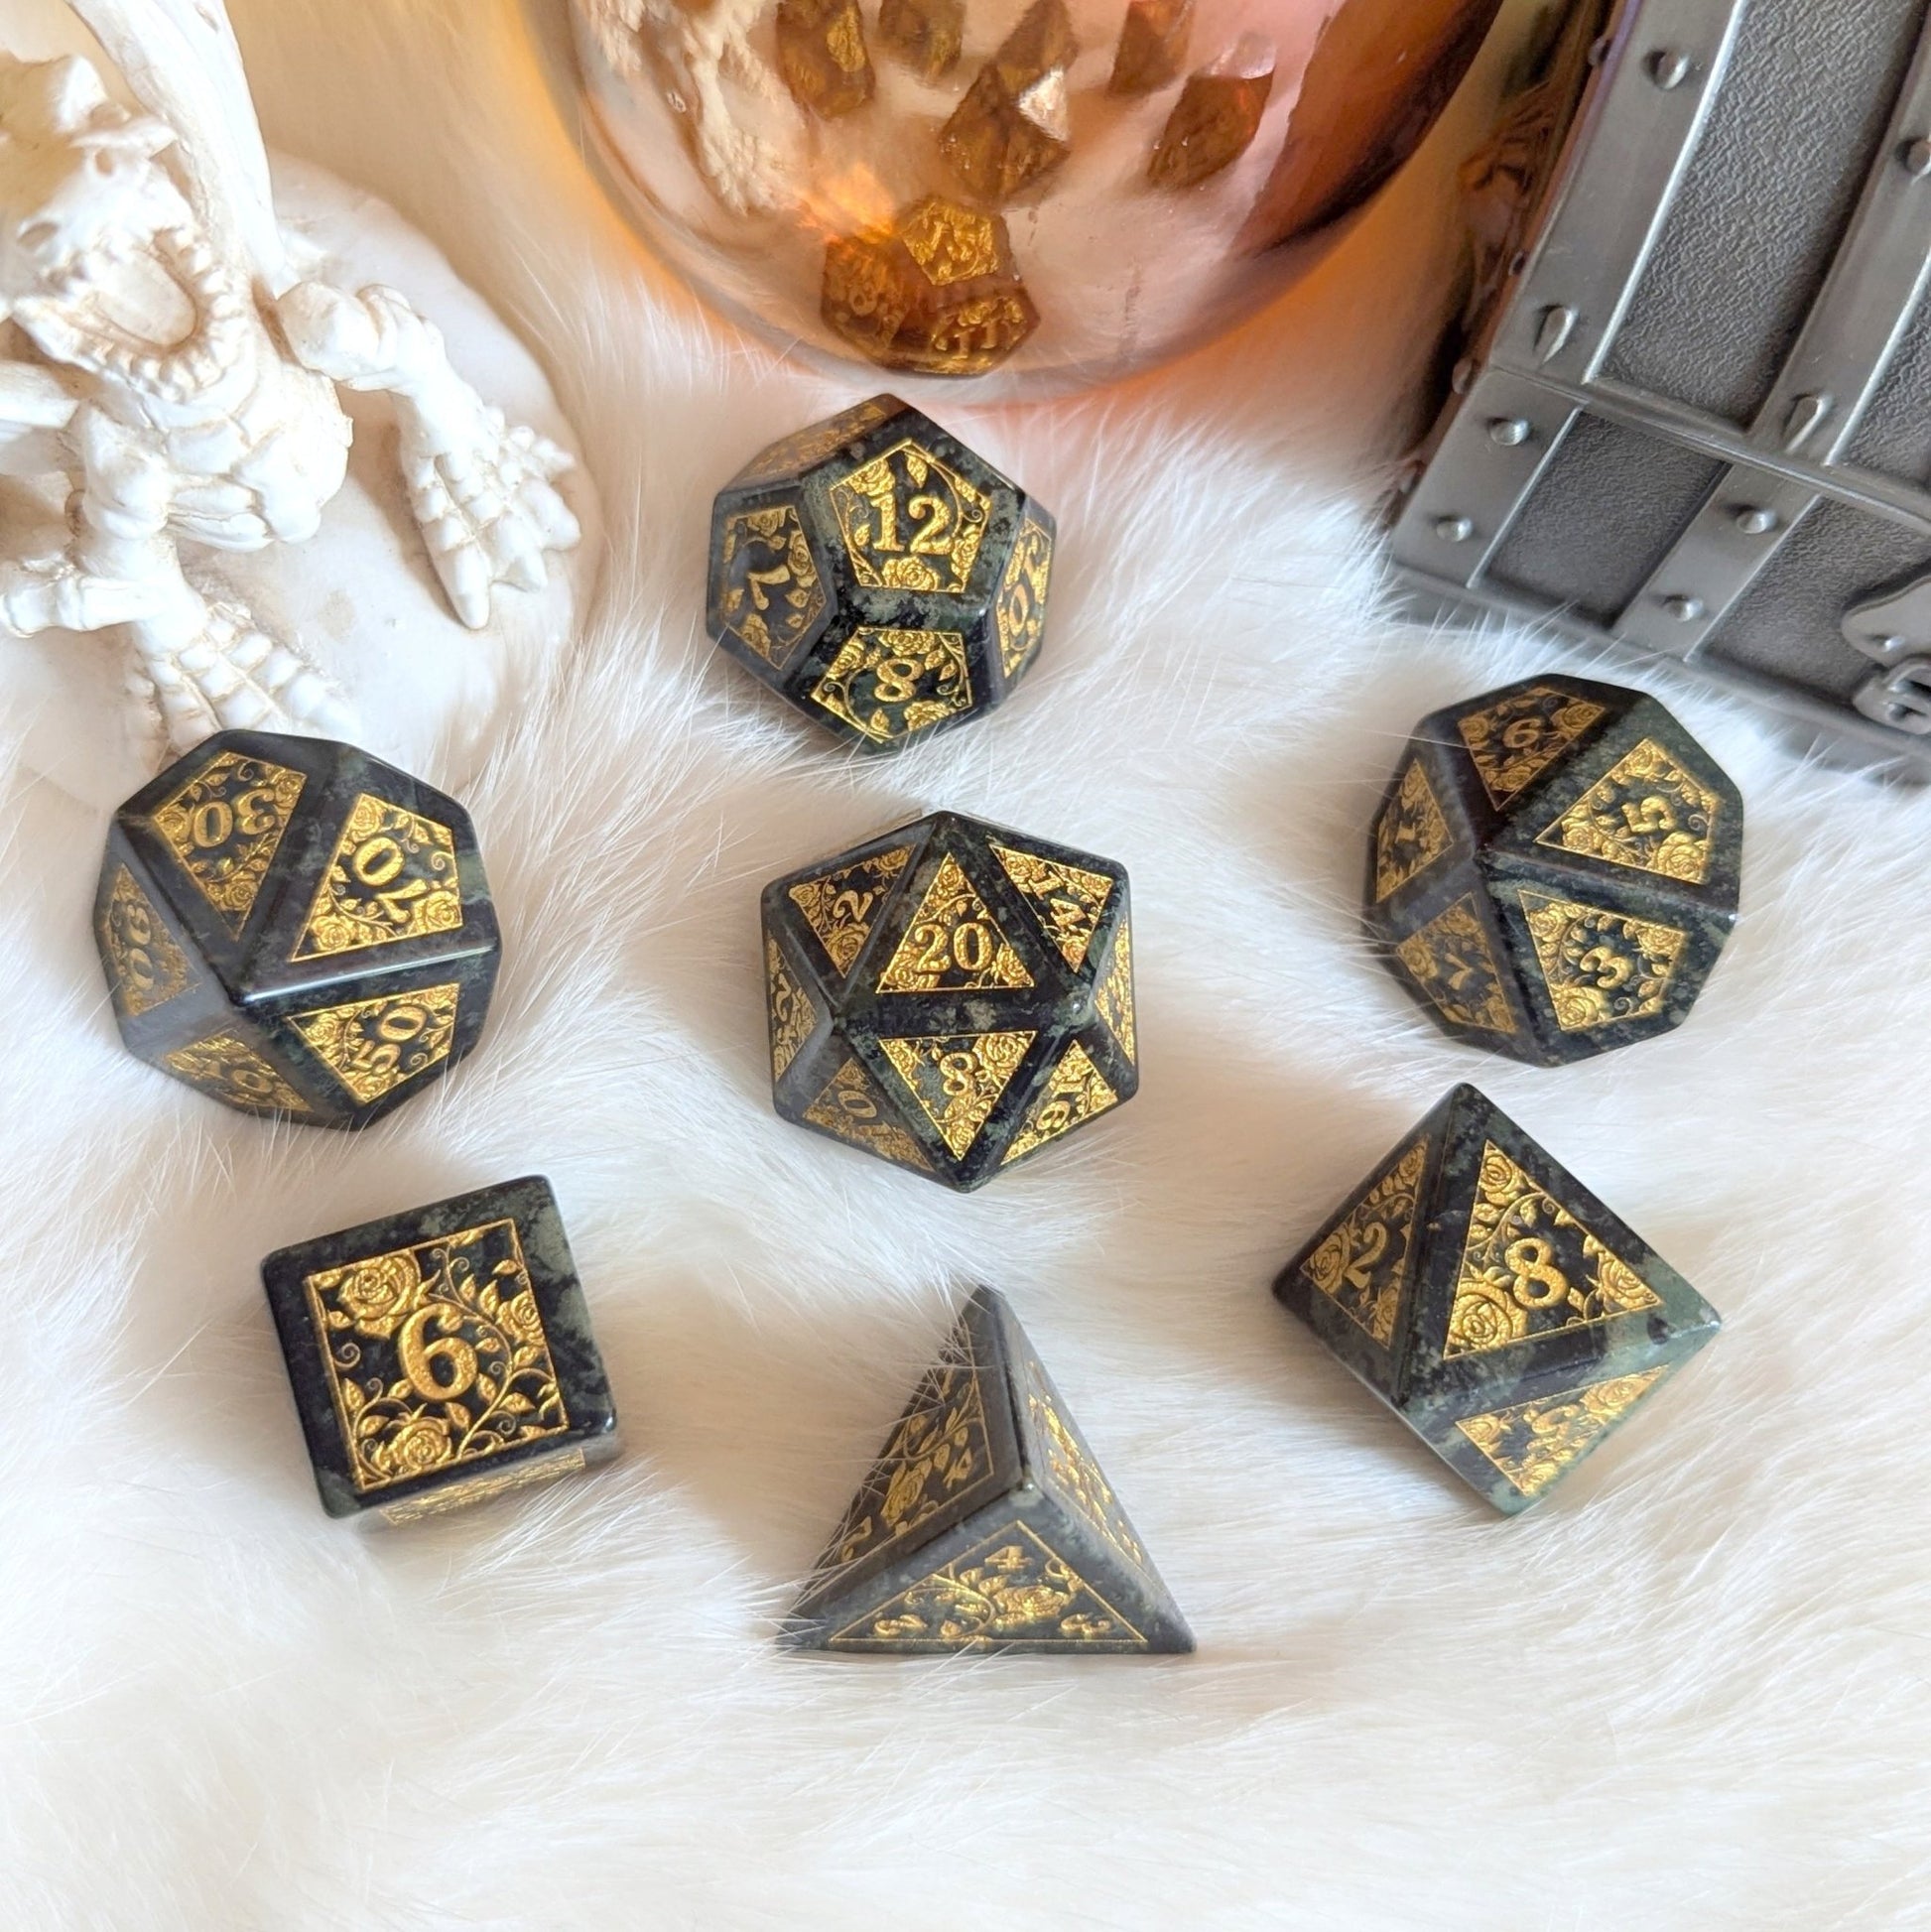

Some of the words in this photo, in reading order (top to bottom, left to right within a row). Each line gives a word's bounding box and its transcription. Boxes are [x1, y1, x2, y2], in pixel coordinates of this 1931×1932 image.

[869, 491, 955, 556] 12
[747, 565, 791, 611] 7
[874, 658, 926, 702] 8
[192, 790, 275, 849] 30
[1621, 796, 1677, 835] 5
[353, 837, 429, 924] 70
[833, 891, 873, 923] 2
[1028, 870, 1087, 932] 14
[914, 923, 991, 973] 20
[1580, 946, 1633, 989] 3
[350, 1004, 429, 1072] 50
[939, 1051, 978, 1096] 8
[1343, 1221, 1387, 1288] 2
[1504, 1237, 1571, 1309] 8
[401, 1302, 479, 1401] 6
[984, 1545, 1033, 1572] 4
